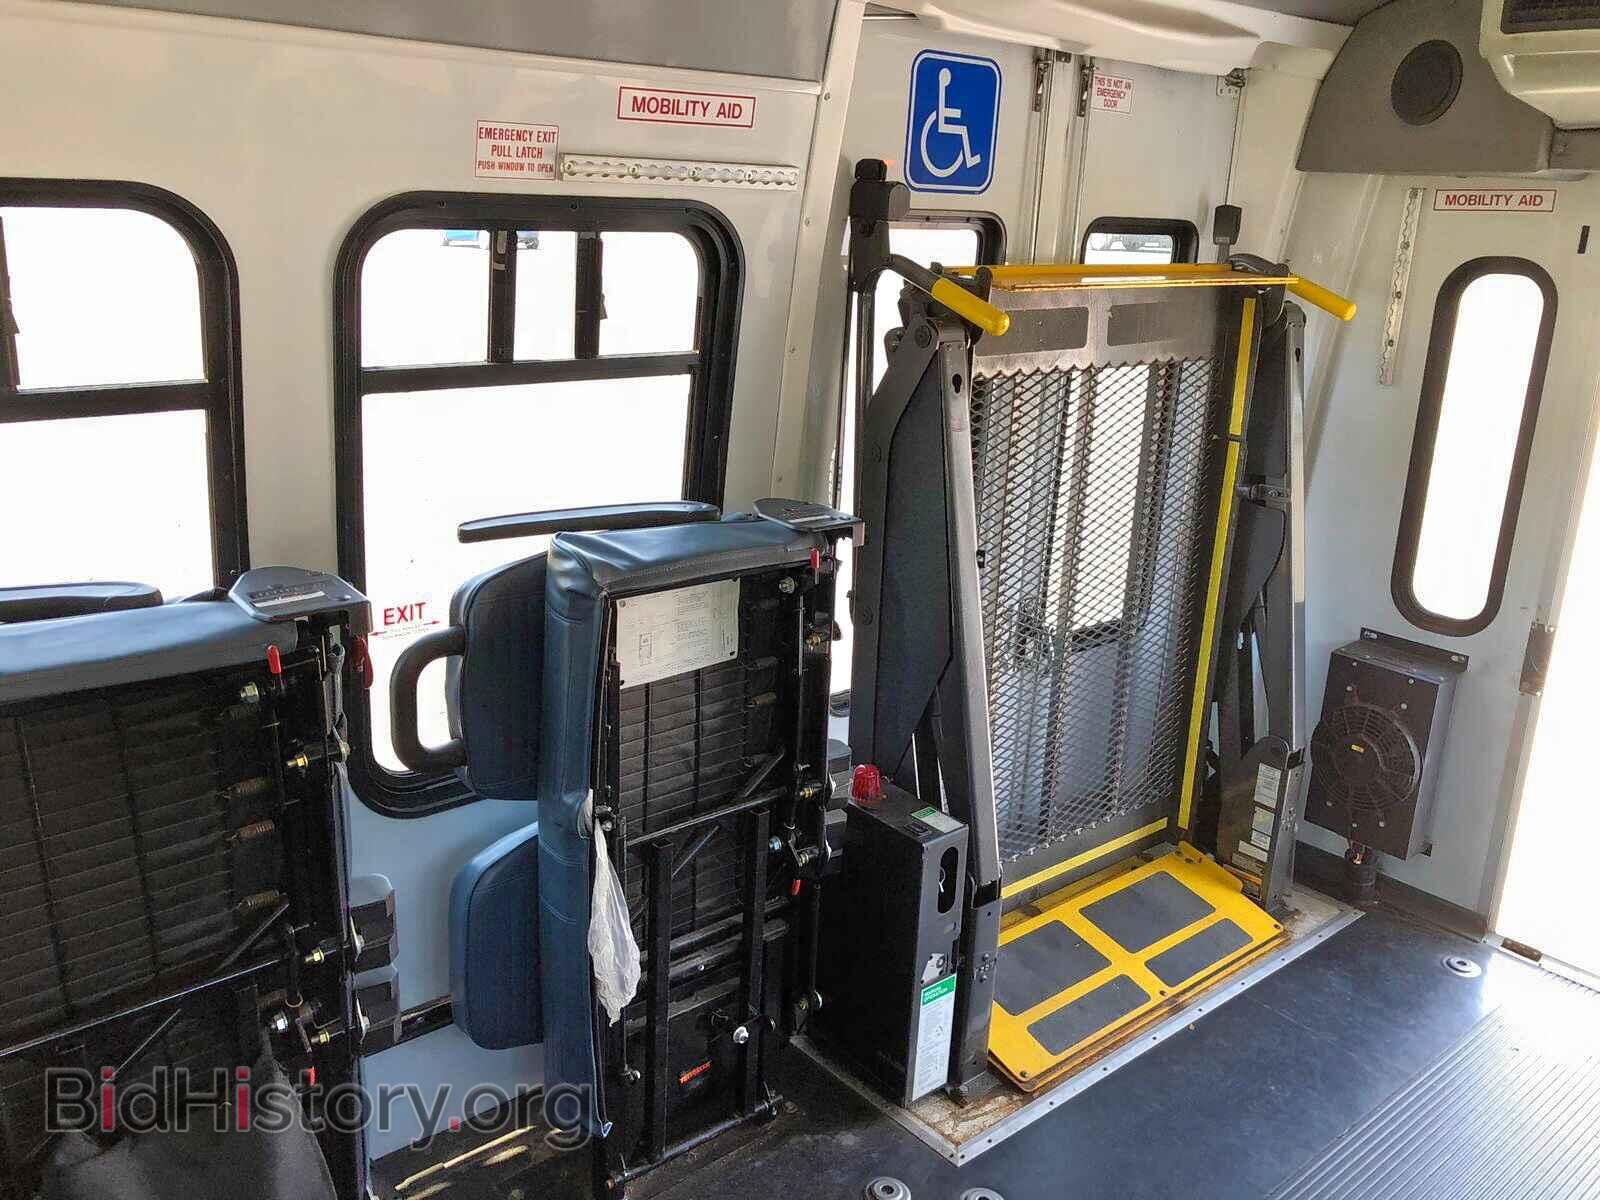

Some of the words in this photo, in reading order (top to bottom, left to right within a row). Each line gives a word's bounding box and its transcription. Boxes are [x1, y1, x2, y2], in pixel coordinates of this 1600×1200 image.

[631, 95, 711, 117] MOBILITY
[716, 102, 743, 119] AID
[478, 126, 534, 143] EMERGENCY
[536, 130, 557, 144] EXIT
[491, 144, 513, 158] PULL
[515, 145, 544, 159] LATCH
[477, 160, 496, 170] PUSH
[498, 161, 525, 172] WINDOW
[527, 162, 536, 172] TO
[537, 163, 554, 173] OPEN
[1444, 193, 1513, 207] MOBILITY
[1518, 194, 1544, 207] AID
[383, 601, 427, 626] EXIT
